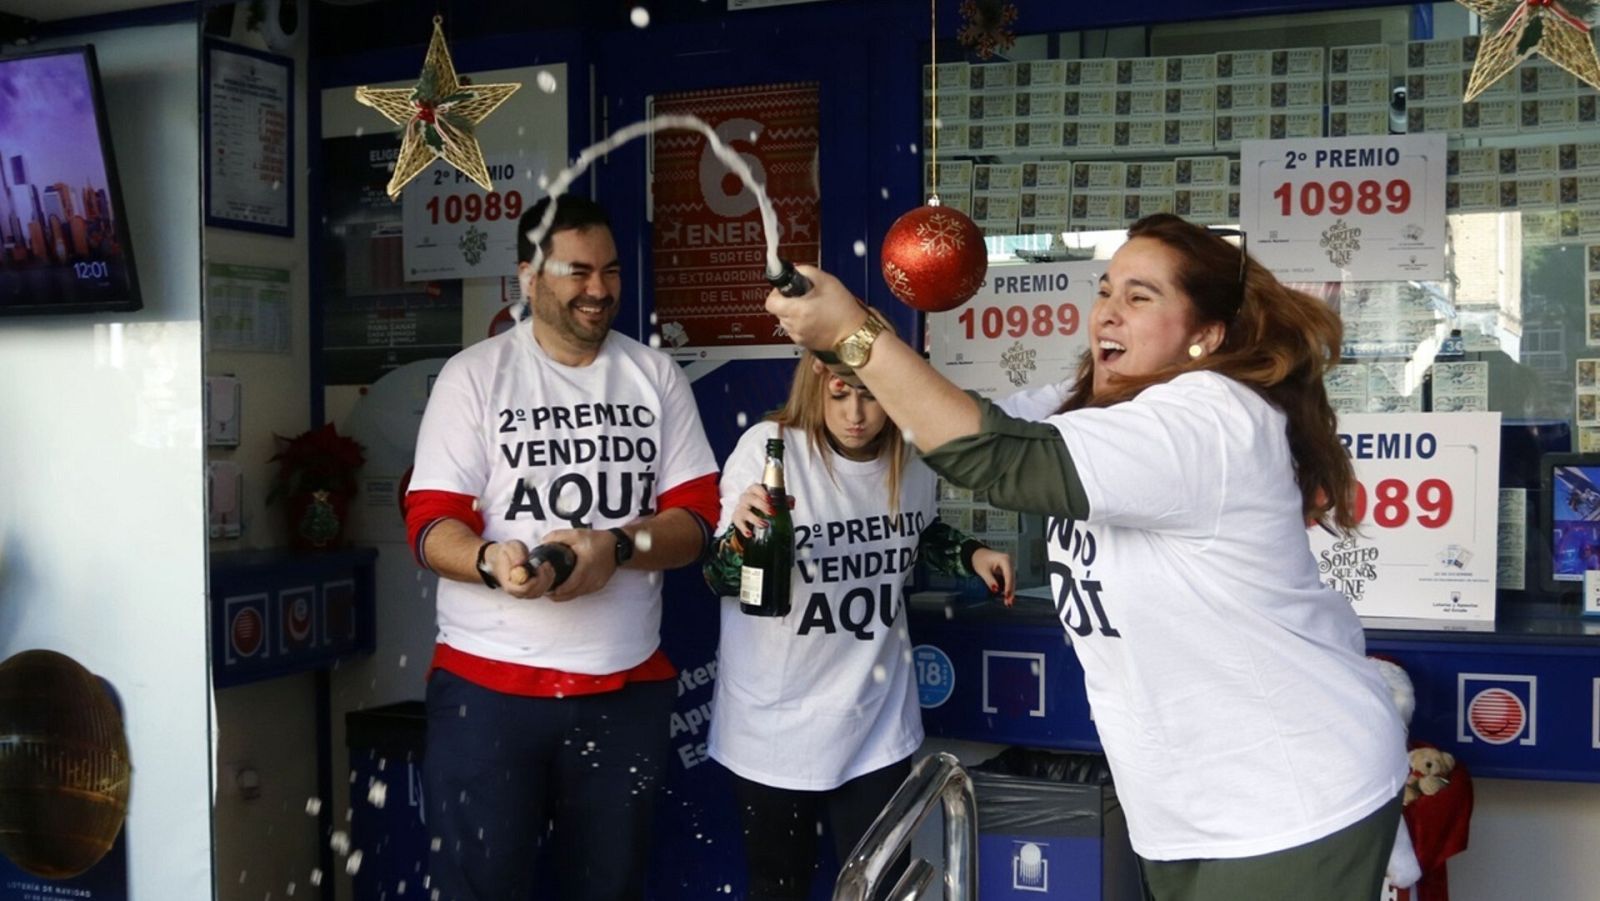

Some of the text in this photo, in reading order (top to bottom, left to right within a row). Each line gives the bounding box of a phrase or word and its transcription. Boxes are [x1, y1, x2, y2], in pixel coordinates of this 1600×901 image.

[699, 117, 767, 218] 6
[1315, 147, 1400, 168] PREMIO
[455, 163, 515, 184] PMIO
[426, 190, 523, 226] 10989
[1273, 178, 1412, 217] 10989
[73, 261, 109, 279] 12:01
[709, 250, 762, 264] SORTEO
[994, 273, 1069, 294] PREMIO
[958, 303, 1080, 340] 10989
[533, 402, 656, 431] PREMIO
[500, 435, 657, 469] VENDIDO
[1338, 432, 1438, 460] REMIO
[505, 466, 656, 529] AQUÍ
[828, 510, 925, 546] PREMIO
[1319, 547, 1379, 574] SORTEO
[1332, 562, 1378, 581] QUE NOS
[797, 584, 904, 641] AQU
[916, 660, 942, 686] 18
